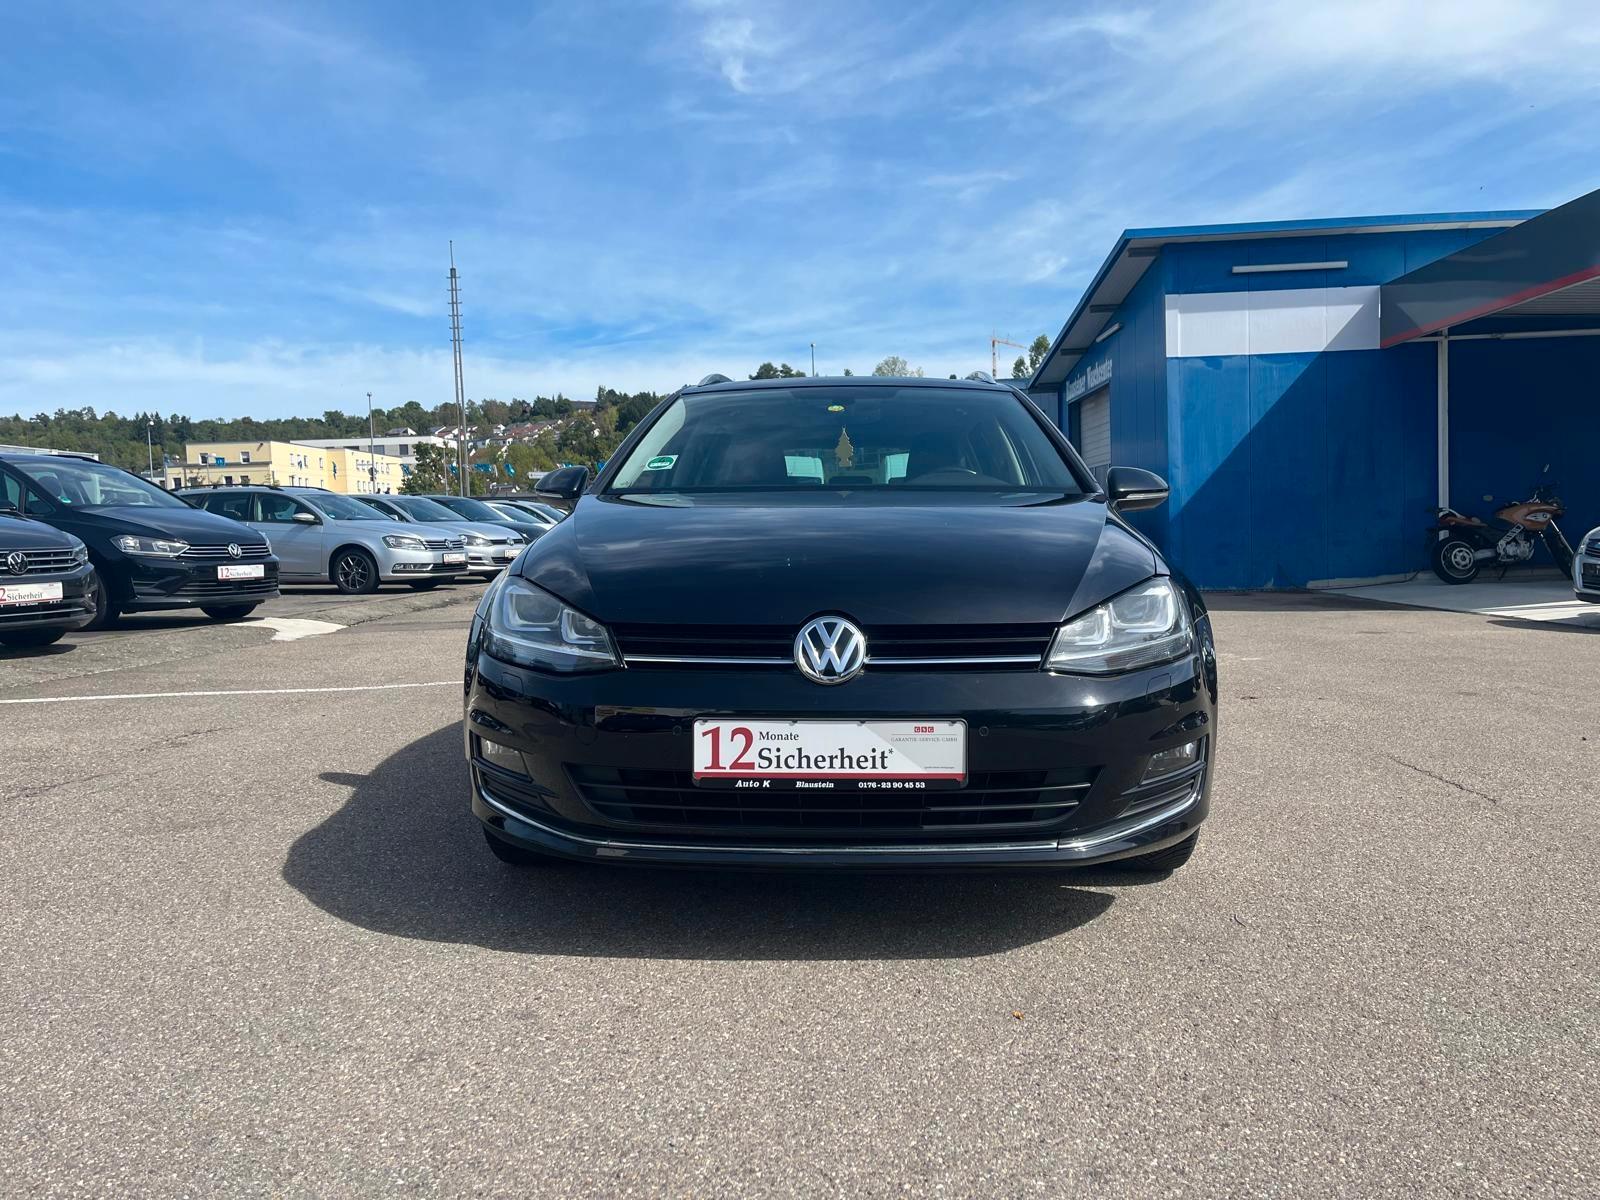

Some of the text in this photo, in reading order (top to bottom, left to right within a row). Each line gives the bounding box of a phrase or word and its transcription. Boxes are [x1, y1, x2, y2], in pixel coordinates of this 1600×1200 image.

[759, 731, 800, 741] Monate
[702, 726, 755, 770] 12
[735, 780, 760, 788] Auto
[762, 780, 771, 788] K
